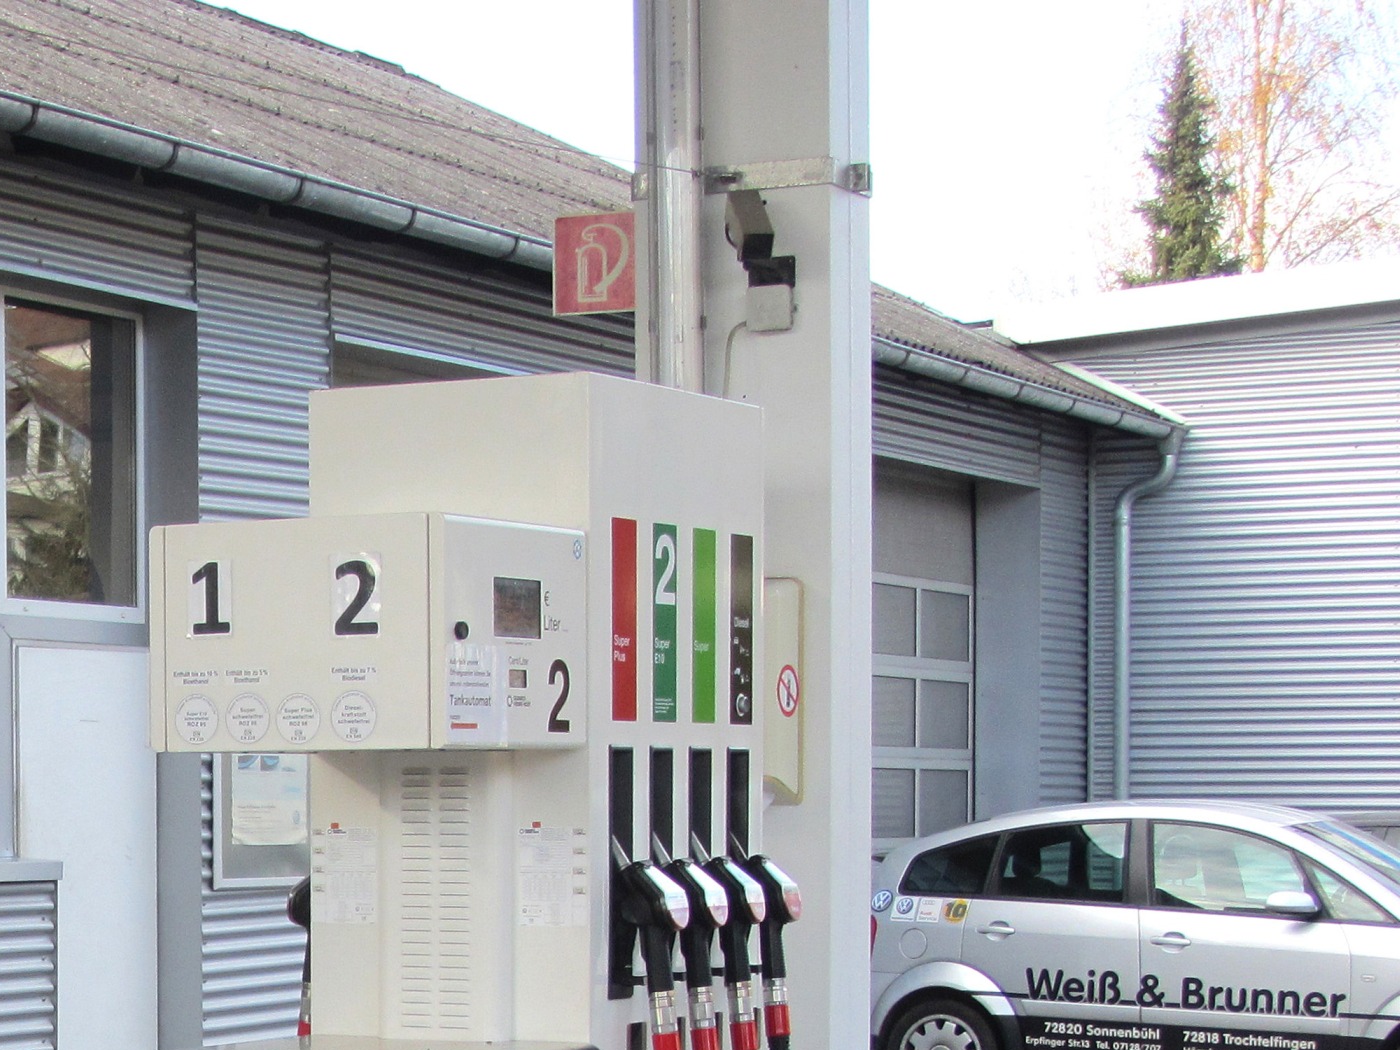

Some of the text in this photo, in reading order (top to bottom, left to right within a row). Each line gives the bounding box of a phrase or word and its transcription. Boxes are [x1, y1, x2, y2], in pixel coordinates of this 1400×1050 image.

[655, 534, 675, 605] 2
[192, 561, 230, 635] 1
[335, 560, 378, 635] 2
[543, 615, 561, 631] Liter
[614, 635, 630, 647] Super
[654, 637, 670, 650] Super
[694, 640, 709, 653] Super
[614, 651, 626, 662] Plus
[654, 653, 665, 664] E10
[450, 694, 491, 706] Tankautomat
[548, 659, 570, 732] 2
[1025, 967, 1346, 1017] Weiß & Brunner
[1044, 1022, 1160, 1040] 72820 Sonnenbühl
[1025, 1036, 1065, 1048] Erpfinger
[1096, 1041, 1110, 1050] Tel.
[1182, 1031, 1316, 1050] 72818 Trochtelfingen
